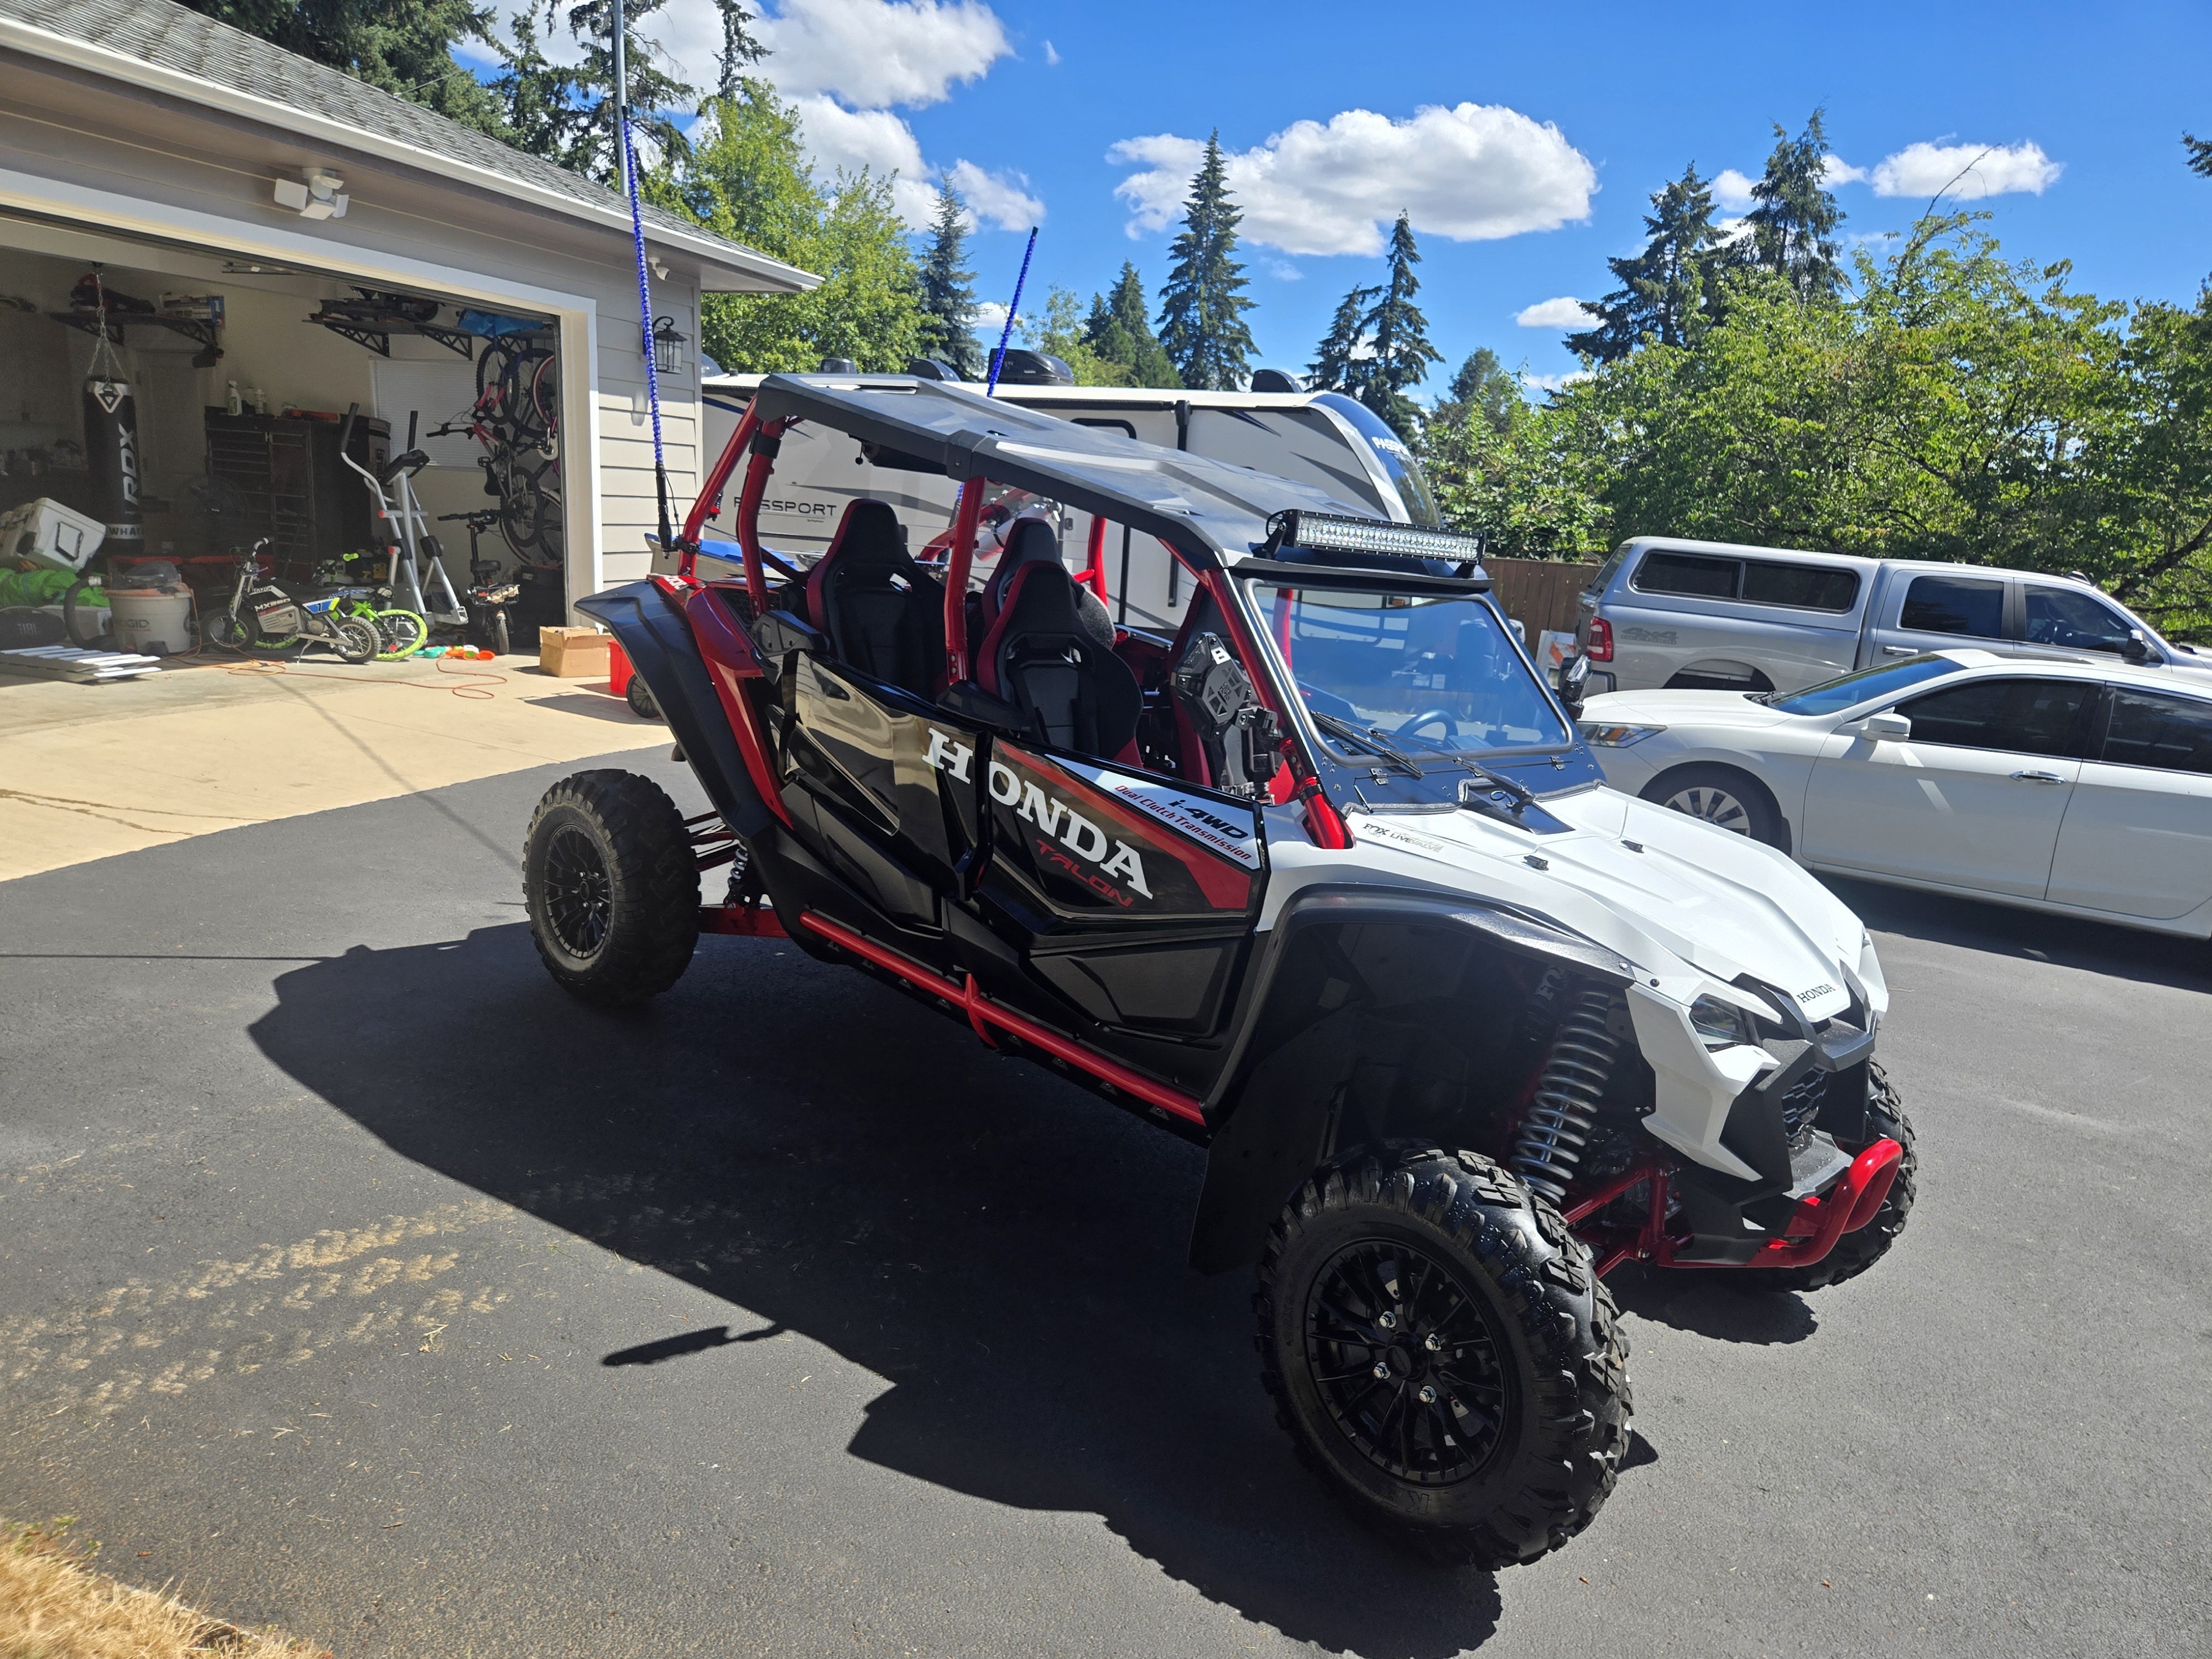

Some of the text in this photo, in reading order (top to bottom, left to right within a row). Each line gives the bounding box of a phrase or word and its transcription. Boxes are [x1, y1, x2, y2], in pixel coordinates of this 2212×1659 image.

[118, 422, 138, 505] RDX
[734, 497, 837, 516] PSSPORT
[922, 727, 1153, 900] HONDA
[1114, 785, 1251, 860] Dual Clutch Transmission
[1168, 800, 1248, 839] i-4WD
[1363, 823, 1390, 837] FOX
[1036, 839, 1133, 907] TALON
[1796, 984, 1836, 1003] HONDA
